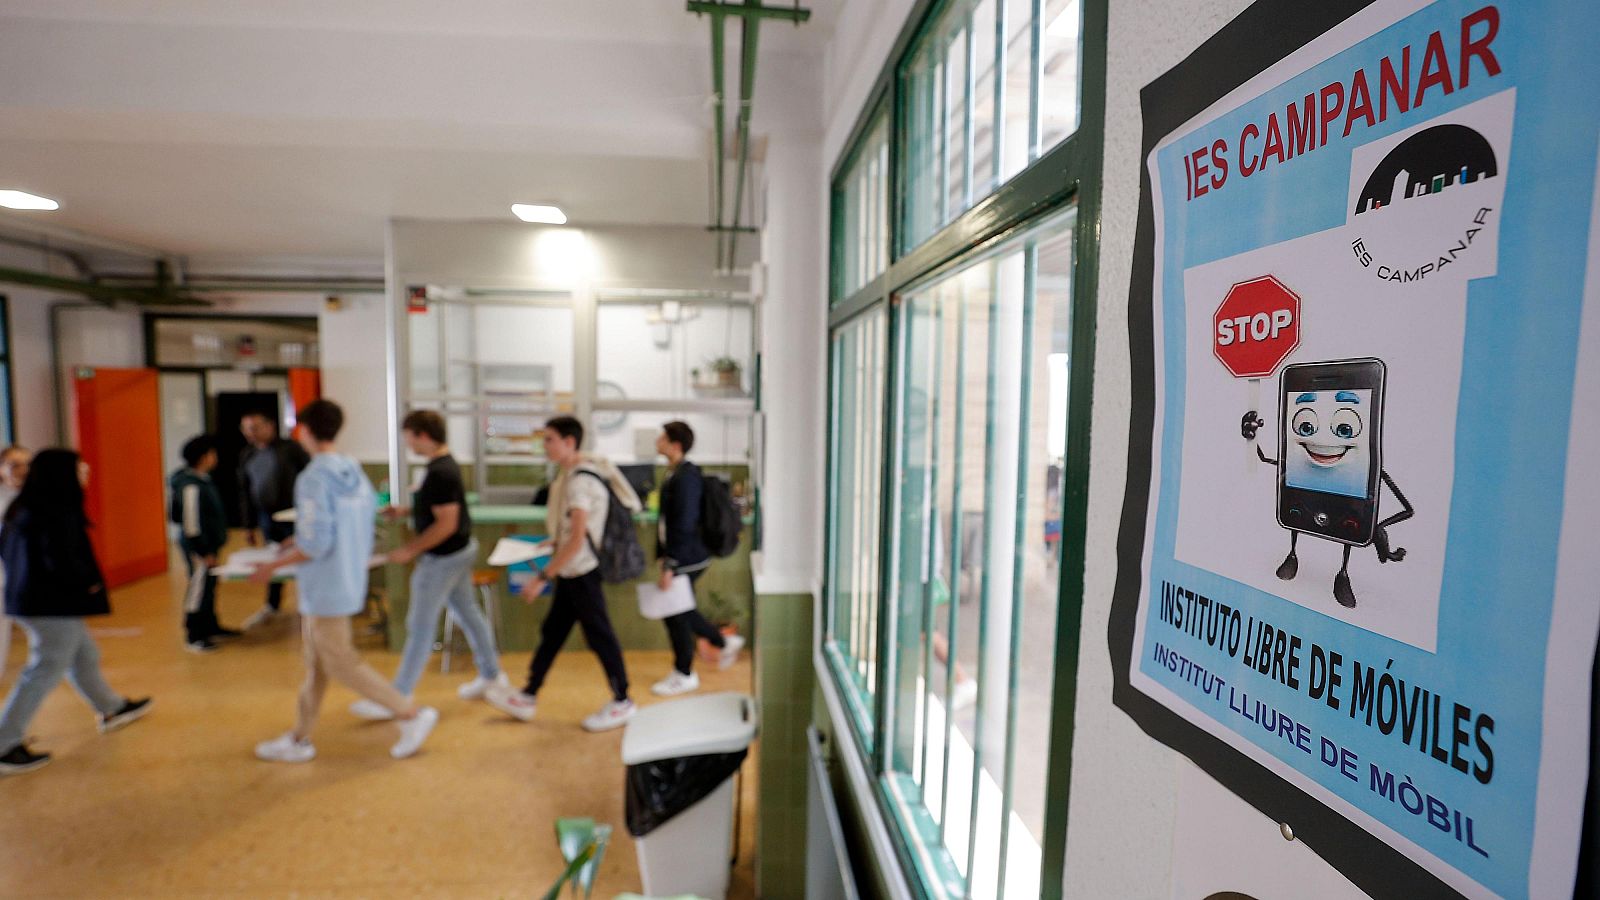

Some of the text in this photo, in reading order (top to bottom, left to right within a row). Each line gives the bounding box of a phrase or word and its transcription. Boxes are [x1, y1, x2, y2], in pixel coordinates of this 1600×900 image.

[1184, 5, 1502, 201] IES CAMPANAR
[1217, 308, 1293, 346] STOP
[1351, 207, 1493, 283] IES CAMPANAR
[1153, 641, 1490, 859] INSTITUT LLIURE DE MÒBIL
[1160, 580, 1496, 785] INSTITUTO LIBRE DE MÓVILES
